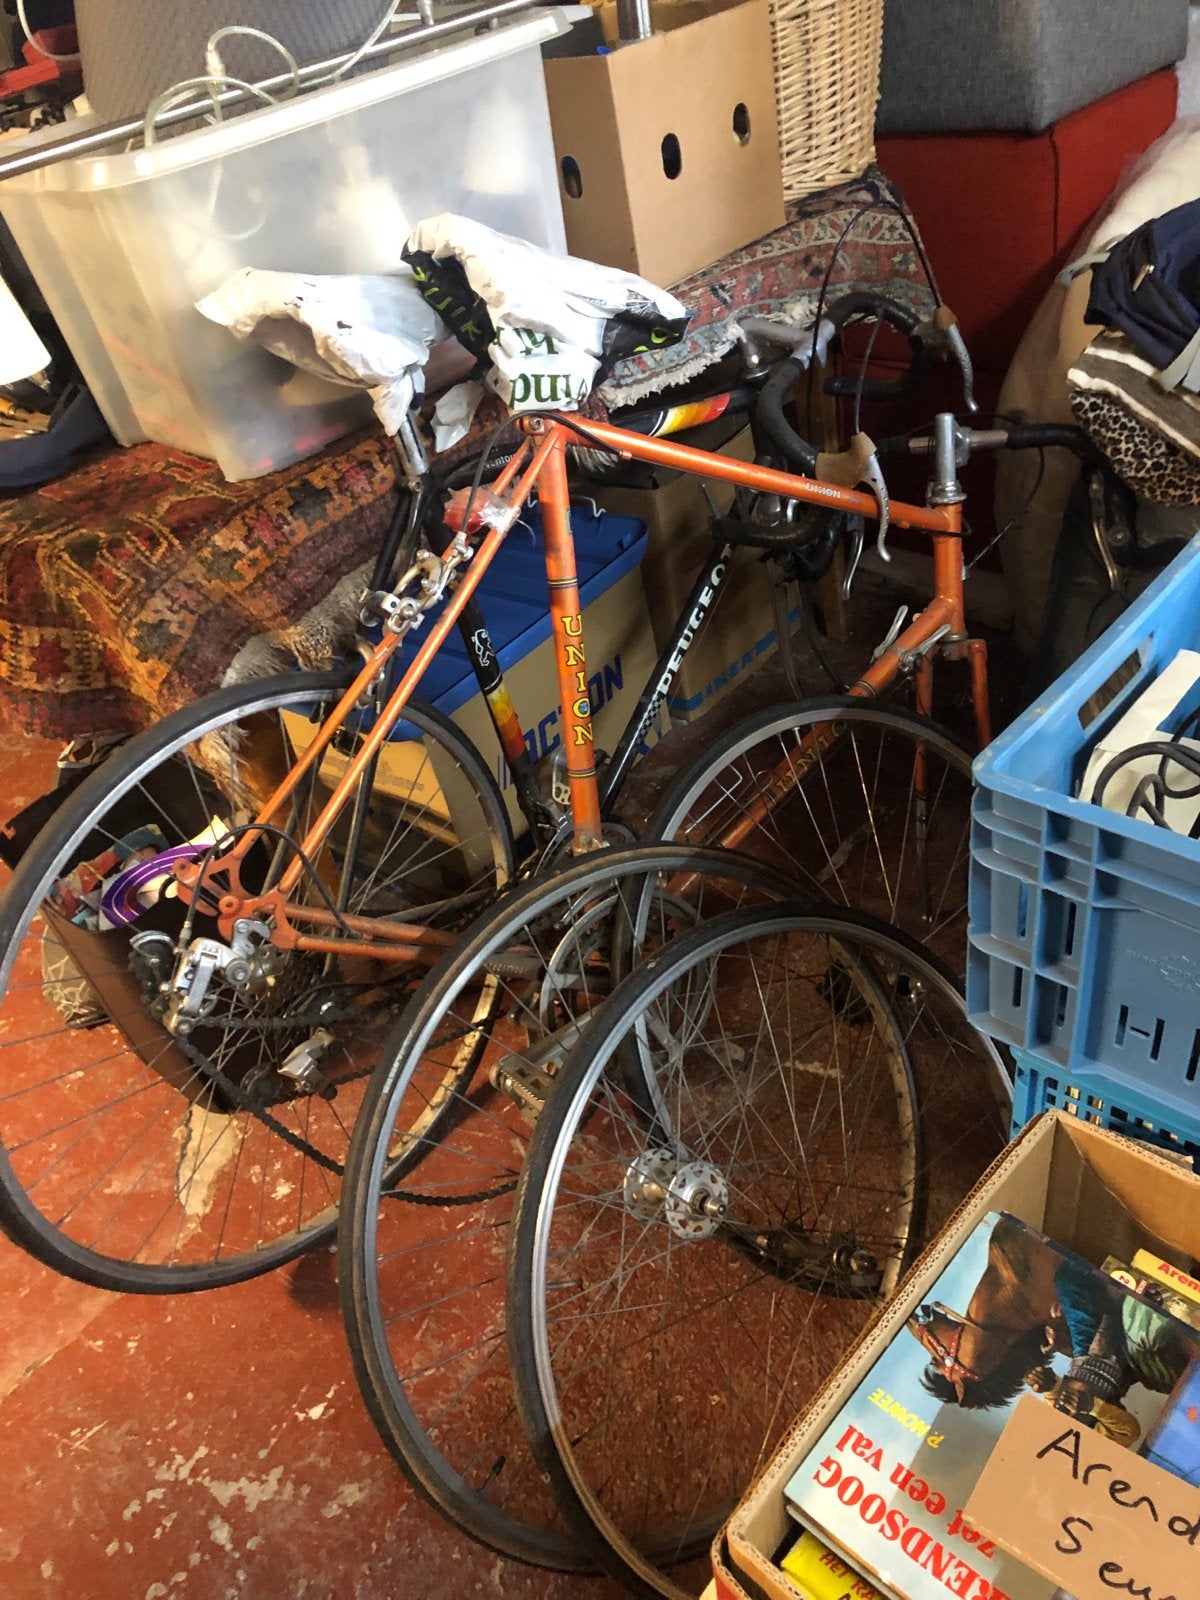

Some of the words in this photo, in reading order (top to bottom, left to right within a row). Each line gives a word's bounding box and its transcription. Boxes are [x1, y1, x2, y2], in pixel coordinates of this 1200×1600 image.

[561, 614, 594, 746] UNION
[776, 720, 848, 793] UNIO
[489, 962, 525, 975] NION
[1157, 1262, 1200, 1293] Aren
[868, 1387, 931, 1438] NOWEE
[835, 1424, 884, 1472] val
[889, 1461, 946, 1515] een
